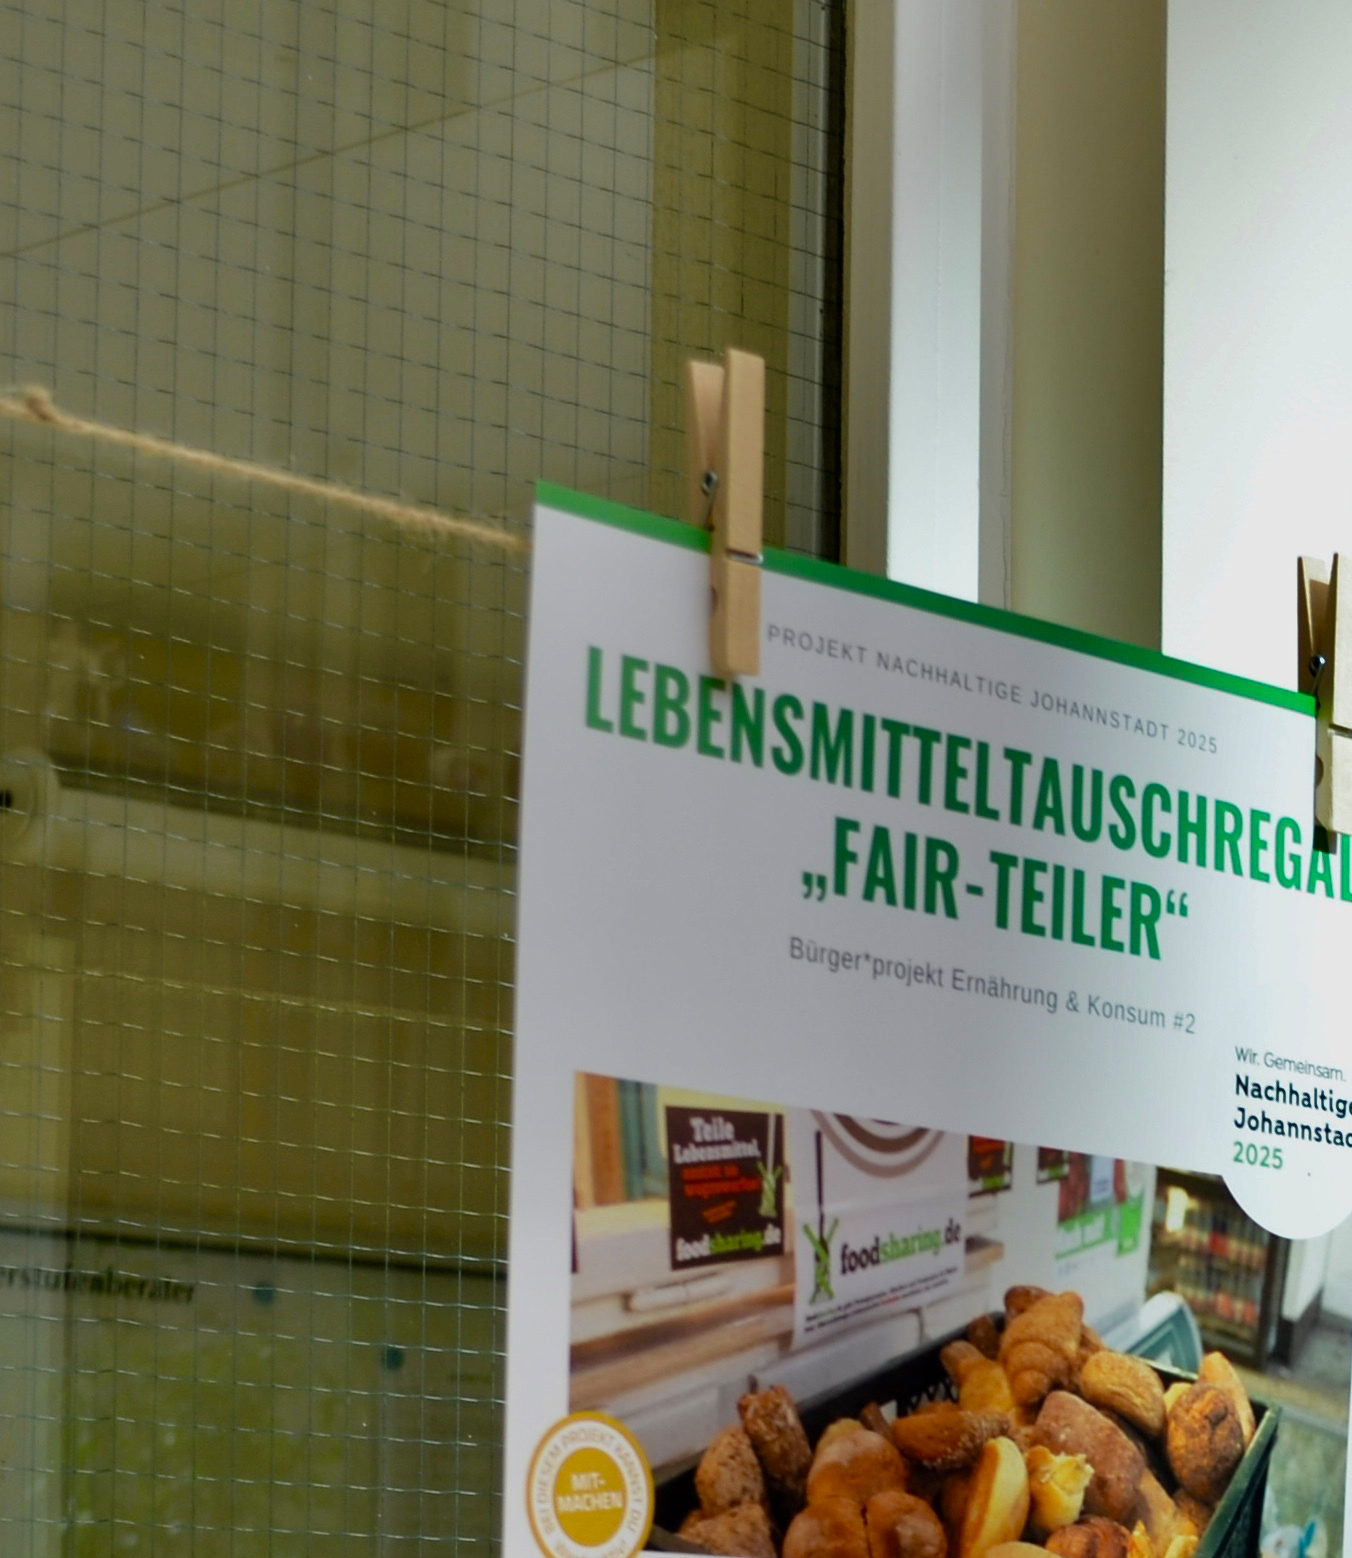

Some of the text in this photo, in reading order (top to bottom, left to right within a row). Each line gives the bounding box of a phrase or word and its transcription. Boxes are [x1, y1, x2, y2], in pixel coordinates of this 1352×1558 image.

[769, 625, 1218, 754] PROJEKT NACHHALTIGE JOHANNSTADT 2025
[802, 818, 1188, 960] „FAIR-TEILER“
[952, 964, 1058, 1014] Ernährung
[1065, 990, 1080, 1013] &
[1088, 992, 1166, 1030] Konsum
[1174, 1011, 1196, 1035] #2
[1235, 1046, 1346, 1081] Wir. Gemeinsam.
[1233, 1141, 1283, 1169] 2025
[840, 1218, 961, 1277] foodsharing.de
[558, 1491, 623, 1513] MACHEN
